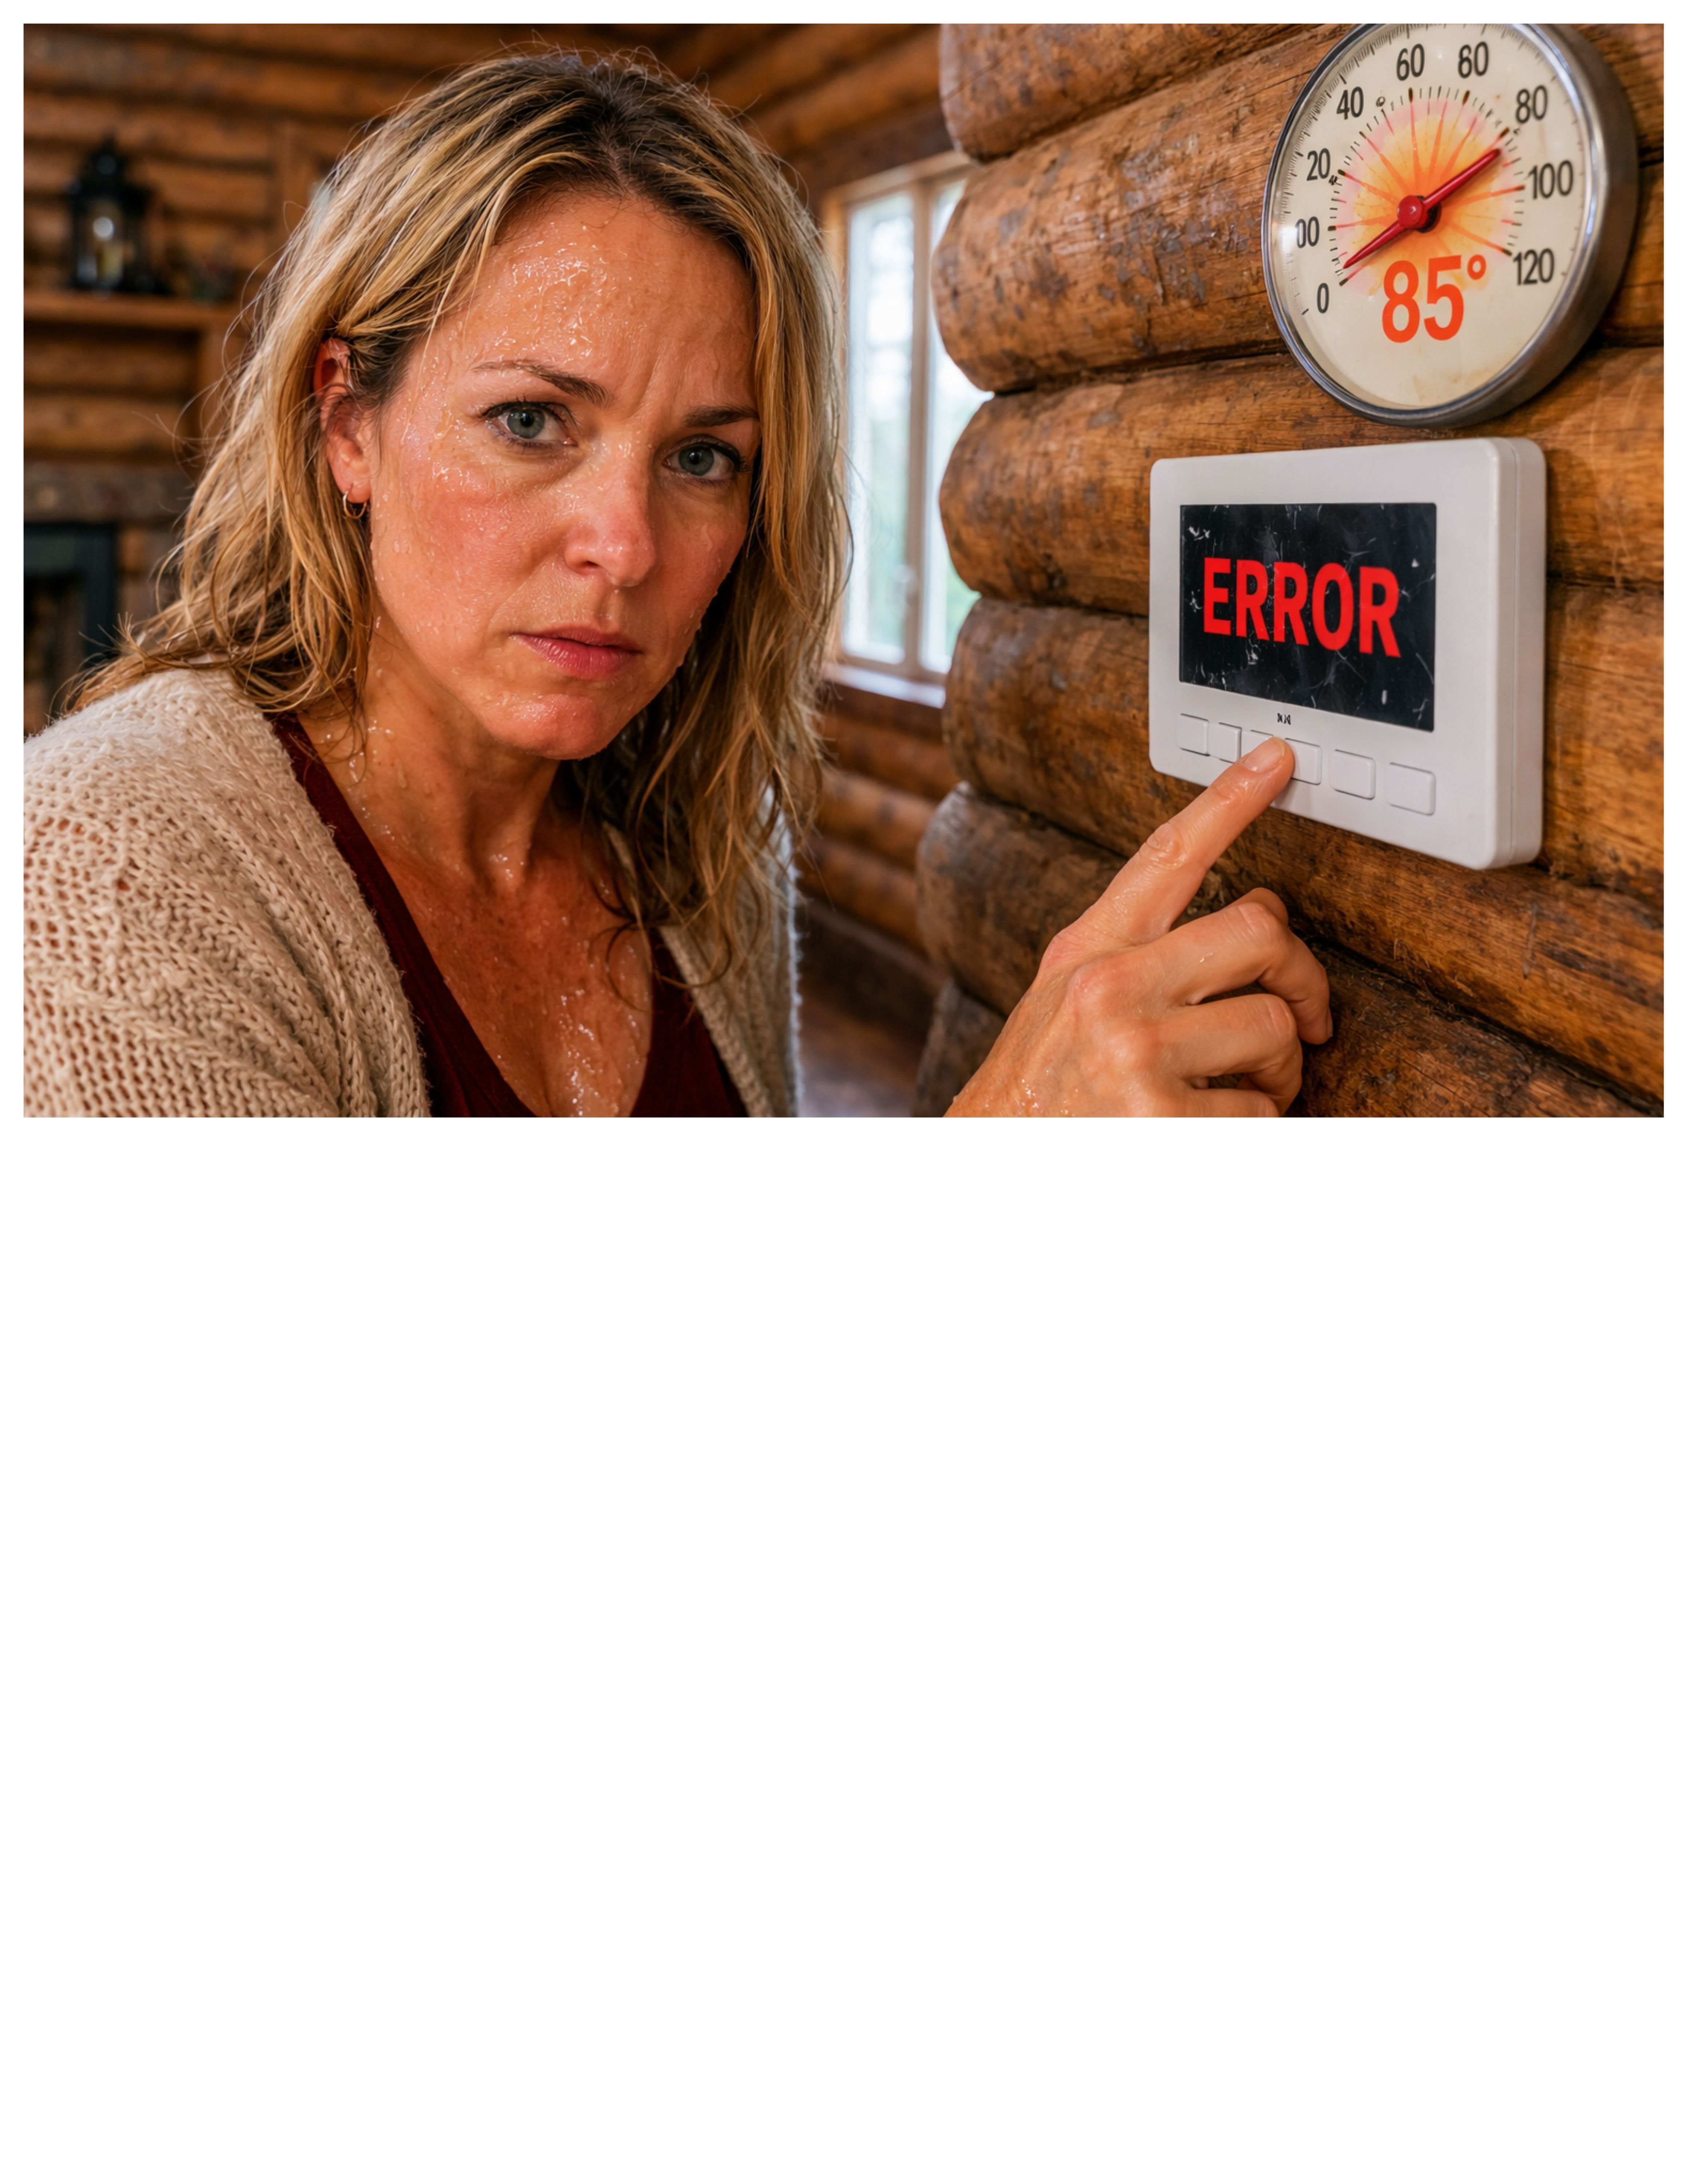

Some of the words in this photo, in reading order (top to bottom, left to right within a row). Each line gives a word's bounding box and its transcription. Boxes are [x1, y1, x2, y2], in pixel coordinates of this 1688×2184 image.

[1396, 43, 1424, 81] 60
[1336, 86, 1364, 120] 40
[1516, 85, 1548, 124] 80
[1306, 148, 1331, 181] 20
[1528, 160, 1573, 200] 100
[1513, 248, 1554, 286] 120
[1317, 282, 1329, 313] 0
[1382, 254, 1486, 343] 85°
[1203, 557, 1401, 658] ERROR
